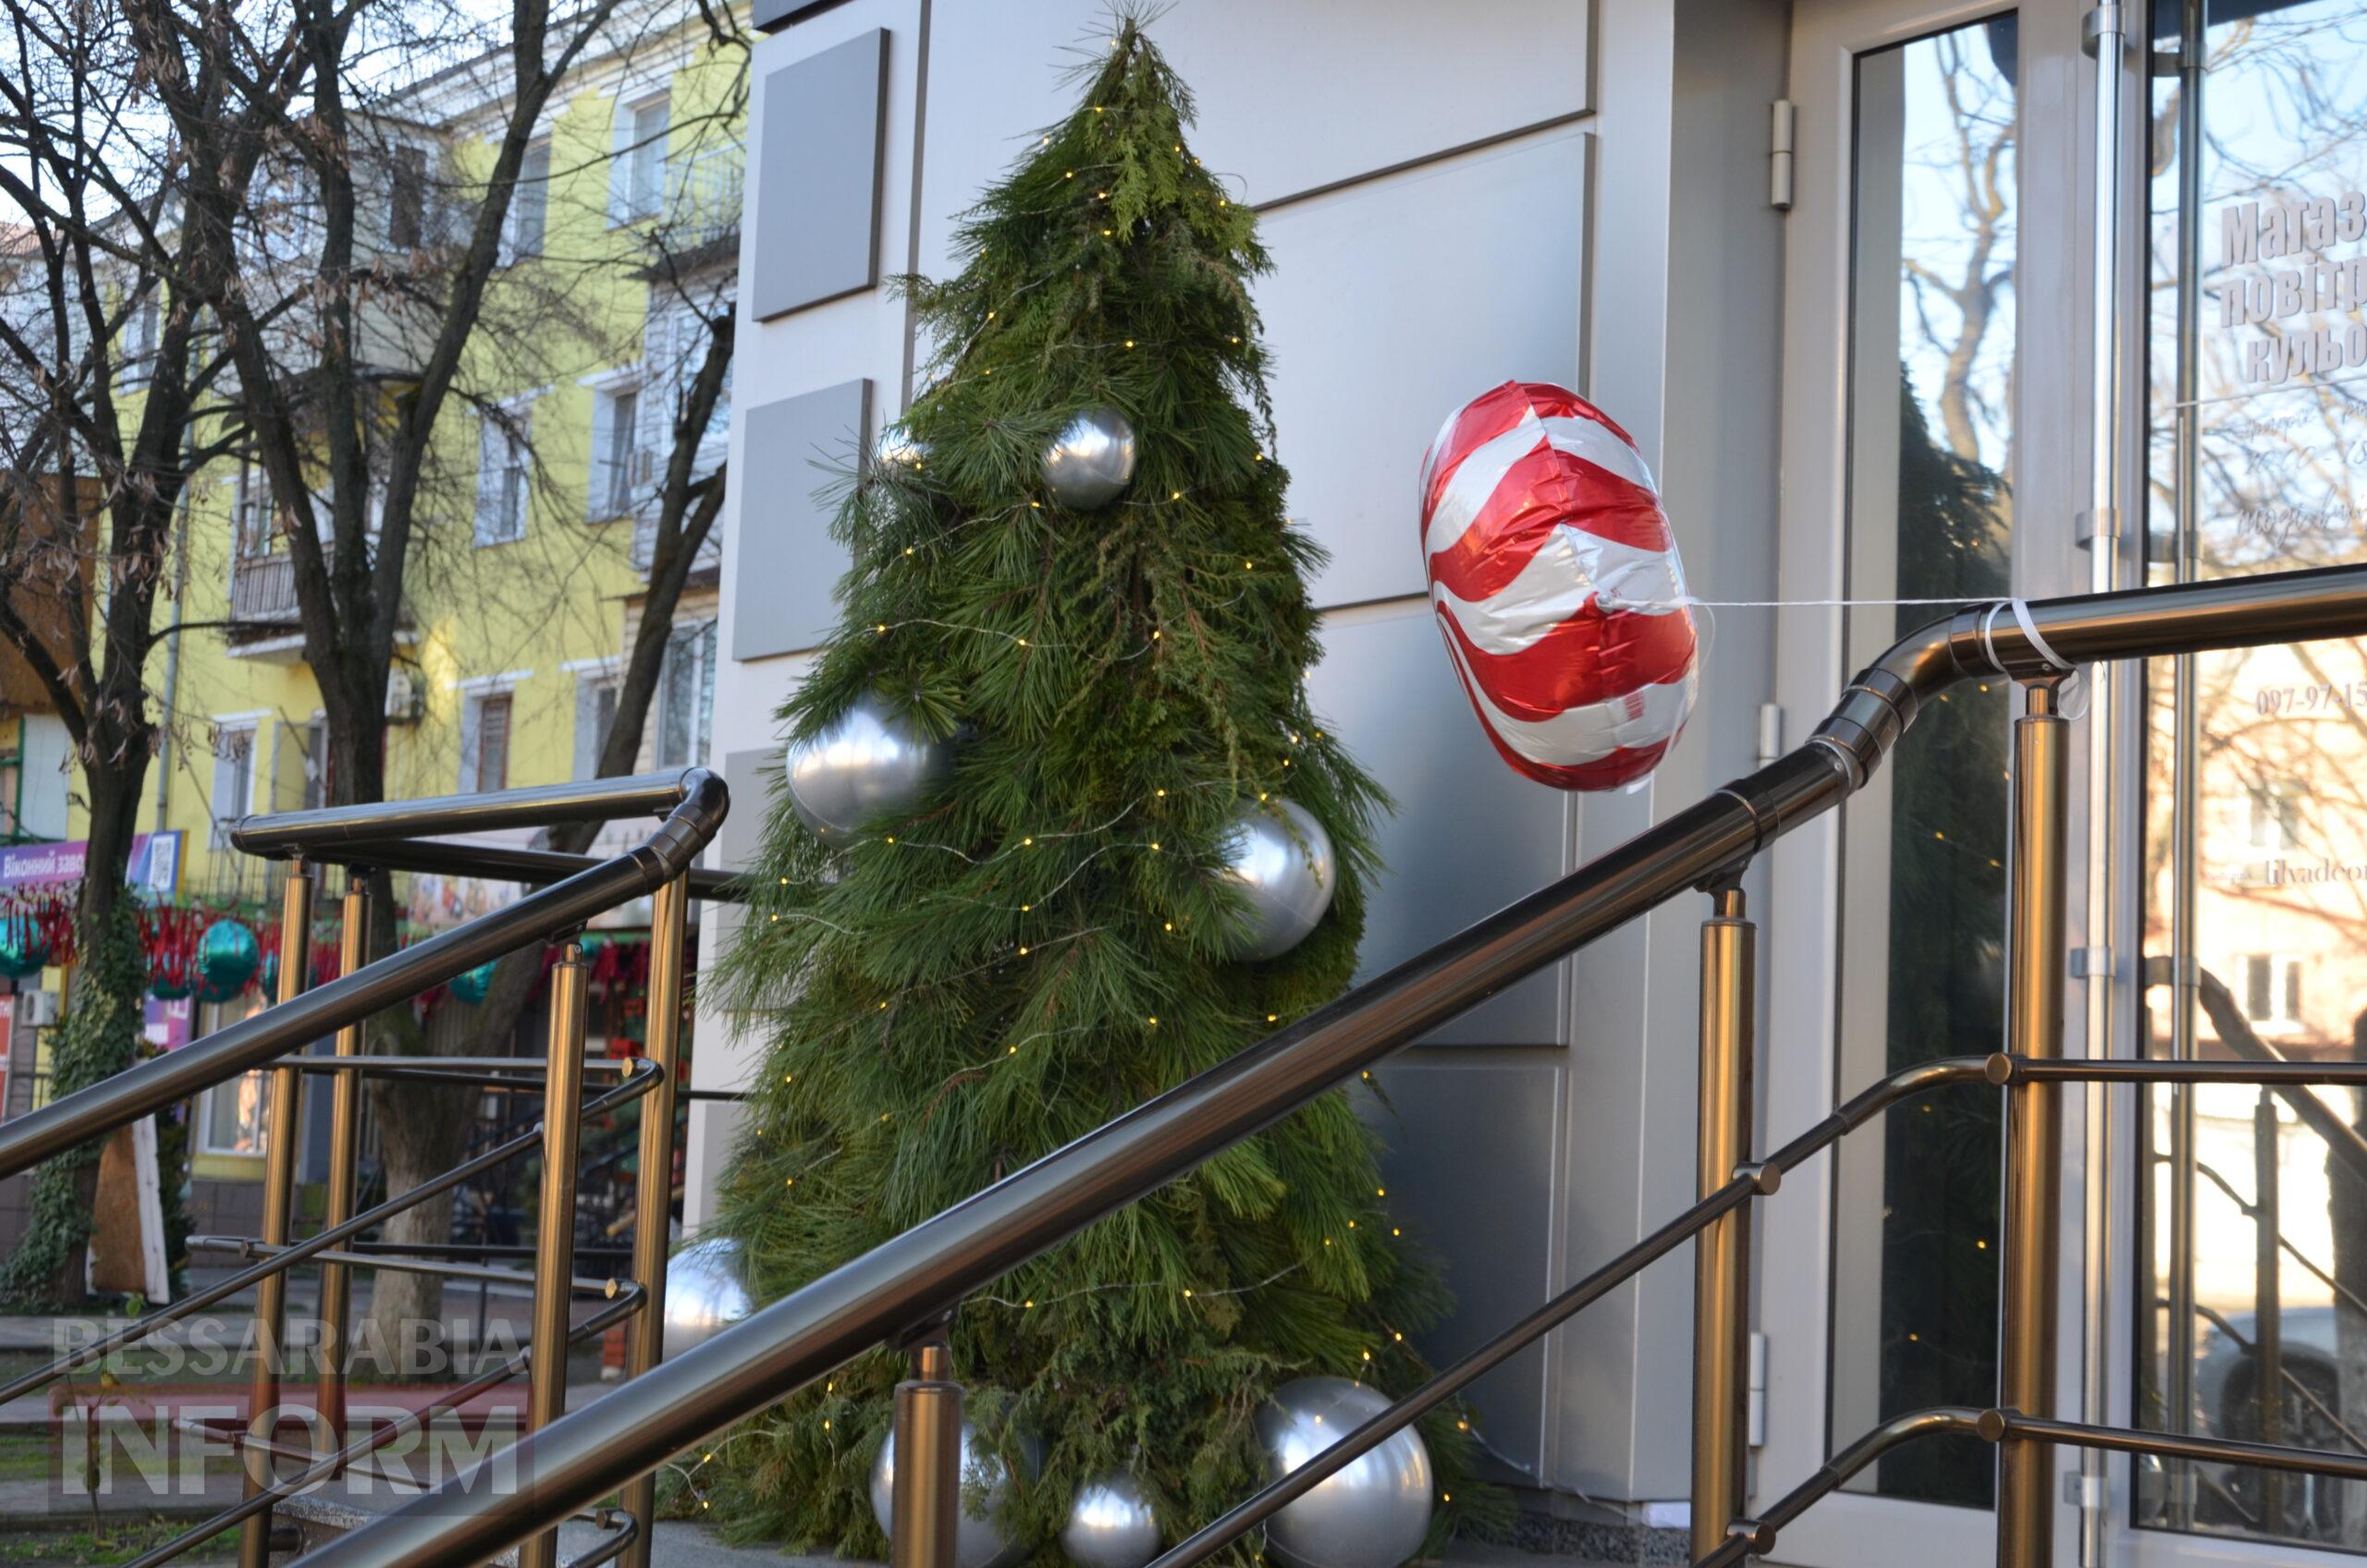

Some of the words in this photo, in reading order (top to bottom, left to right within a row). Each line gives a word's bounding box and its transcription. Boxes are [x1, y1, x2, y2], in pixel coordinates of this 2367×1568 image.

[2221, 191, 2366, 268] Магаз
[2220, 256, 2367, 328] повітр
[2247, 324, 2367, 386] кульо
[4, 850, 55, 878] Віконний
